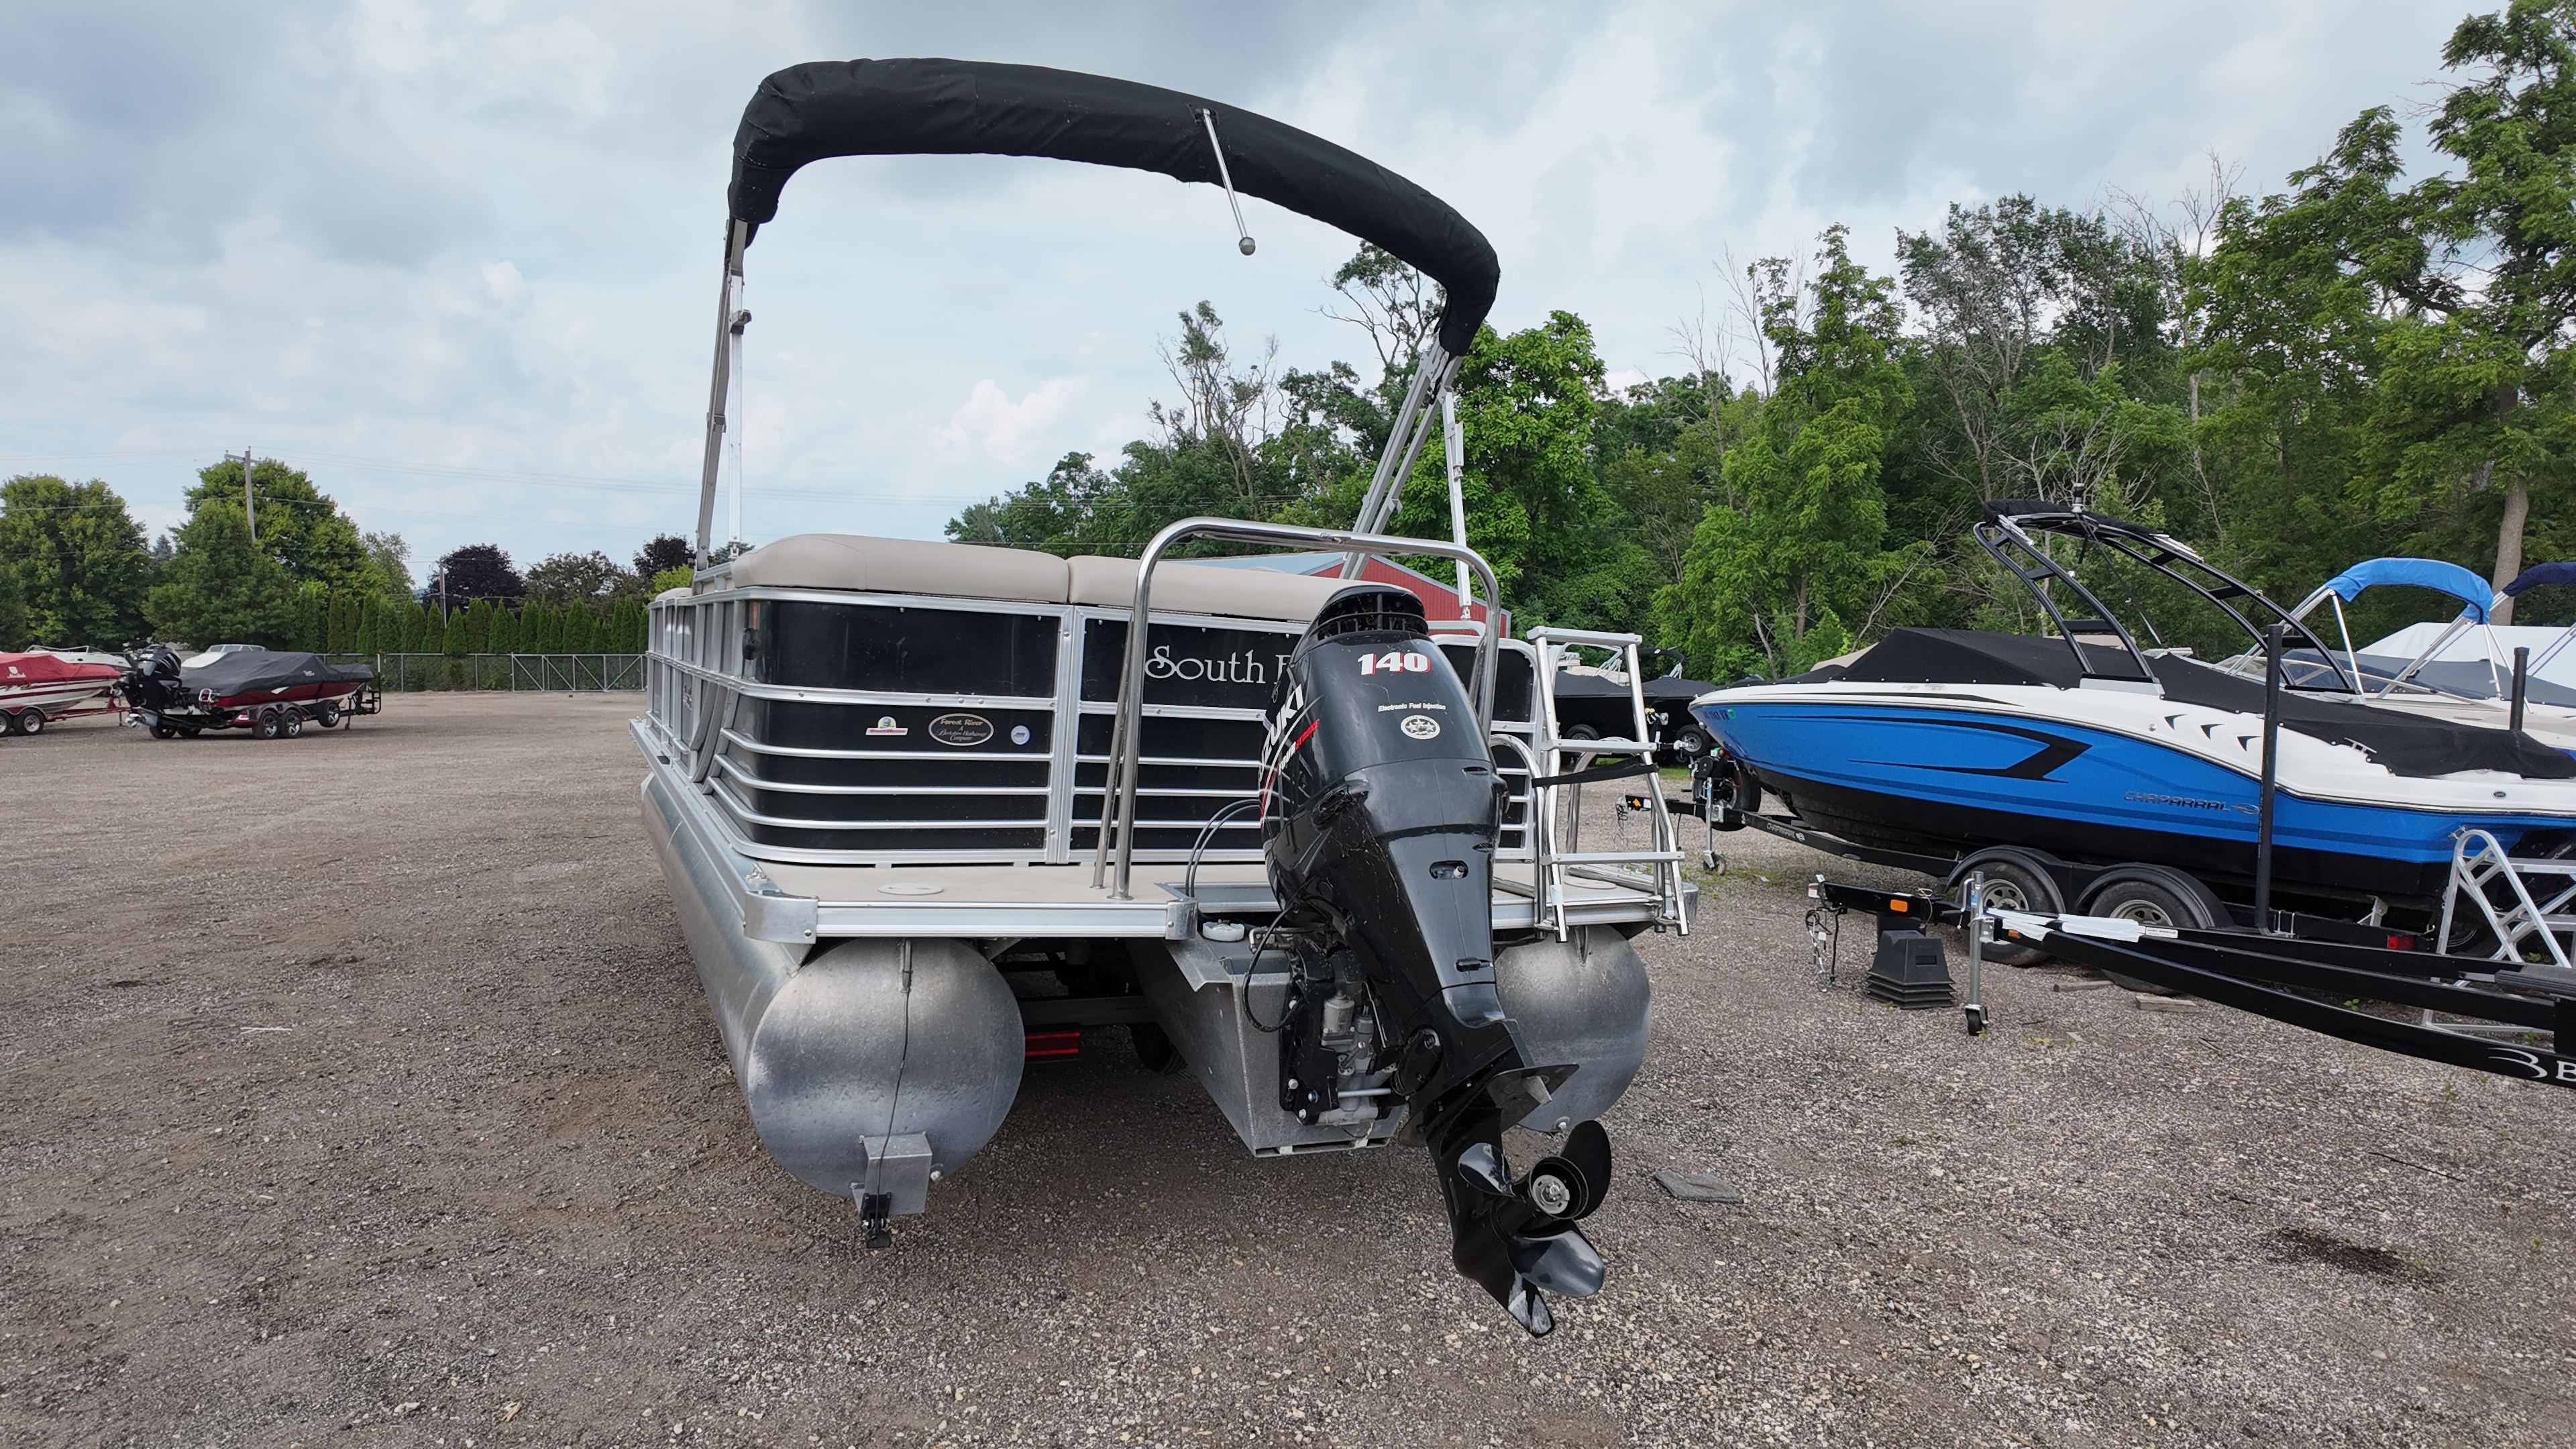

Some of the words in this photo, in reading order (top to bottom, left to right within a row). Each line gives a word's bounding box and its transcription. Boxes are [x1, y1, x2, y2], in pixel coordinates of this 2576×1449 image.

[1144, 645, 1266, 685] South
[1358, 651, 1432, 677] 140
[1378, 702, 1407, 712] Electronic
[1423, 702, 1446, 710] Injection
[2124, 791, 2231, 812] CHAPARRAL
